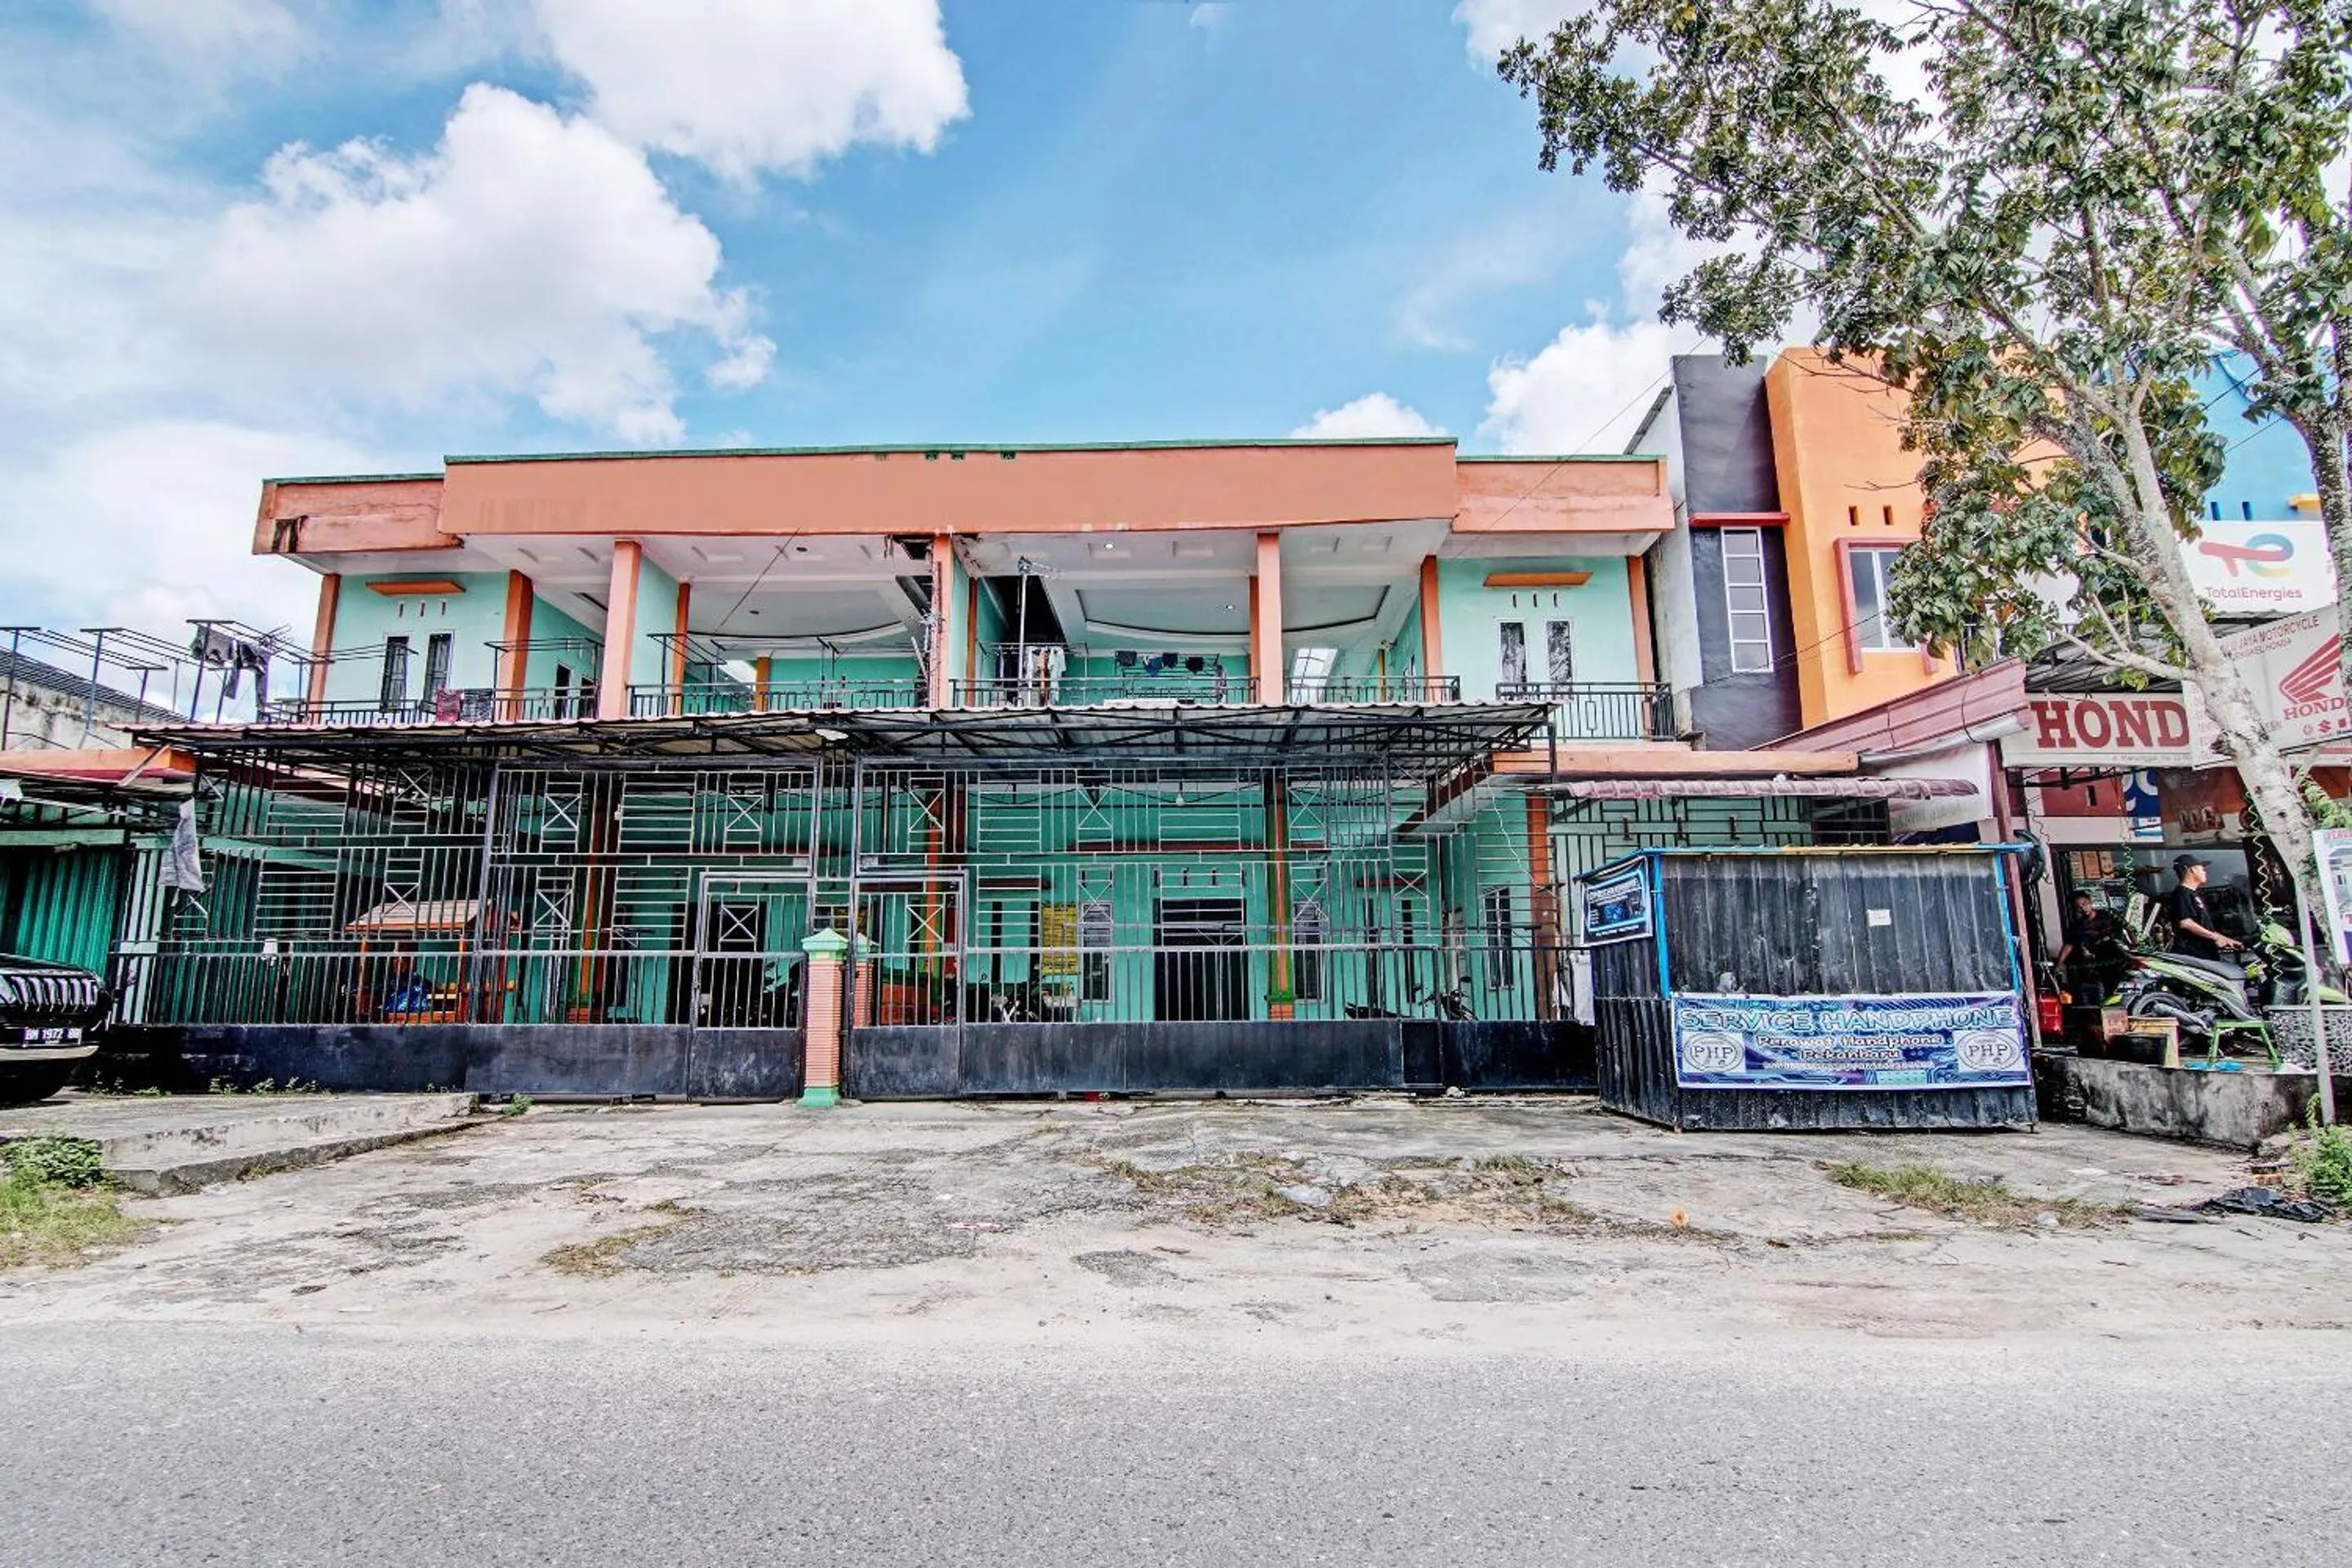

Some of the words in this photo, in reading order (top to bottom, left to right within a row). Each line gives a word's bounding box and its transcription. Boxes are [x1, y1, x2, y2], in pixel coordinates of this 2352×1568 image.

[2205, 586, 2303, 601] TotalEnergies
[2258, 613, 2320, 643] MOTORCYCLE
[2283, 697, 2345, 720] HOND
[2029, 700, 2190, 749] HOND
[1679, 1008, 1812, 1032] SERVICE
[1820, 1006, 2017, 1031] HANDPHONE
[1842, 1034, 1944, 1049] Handphone
[1967, 1043, 2008, 1058] PHP
[1690, 1045, 1735, 1060] PHP
